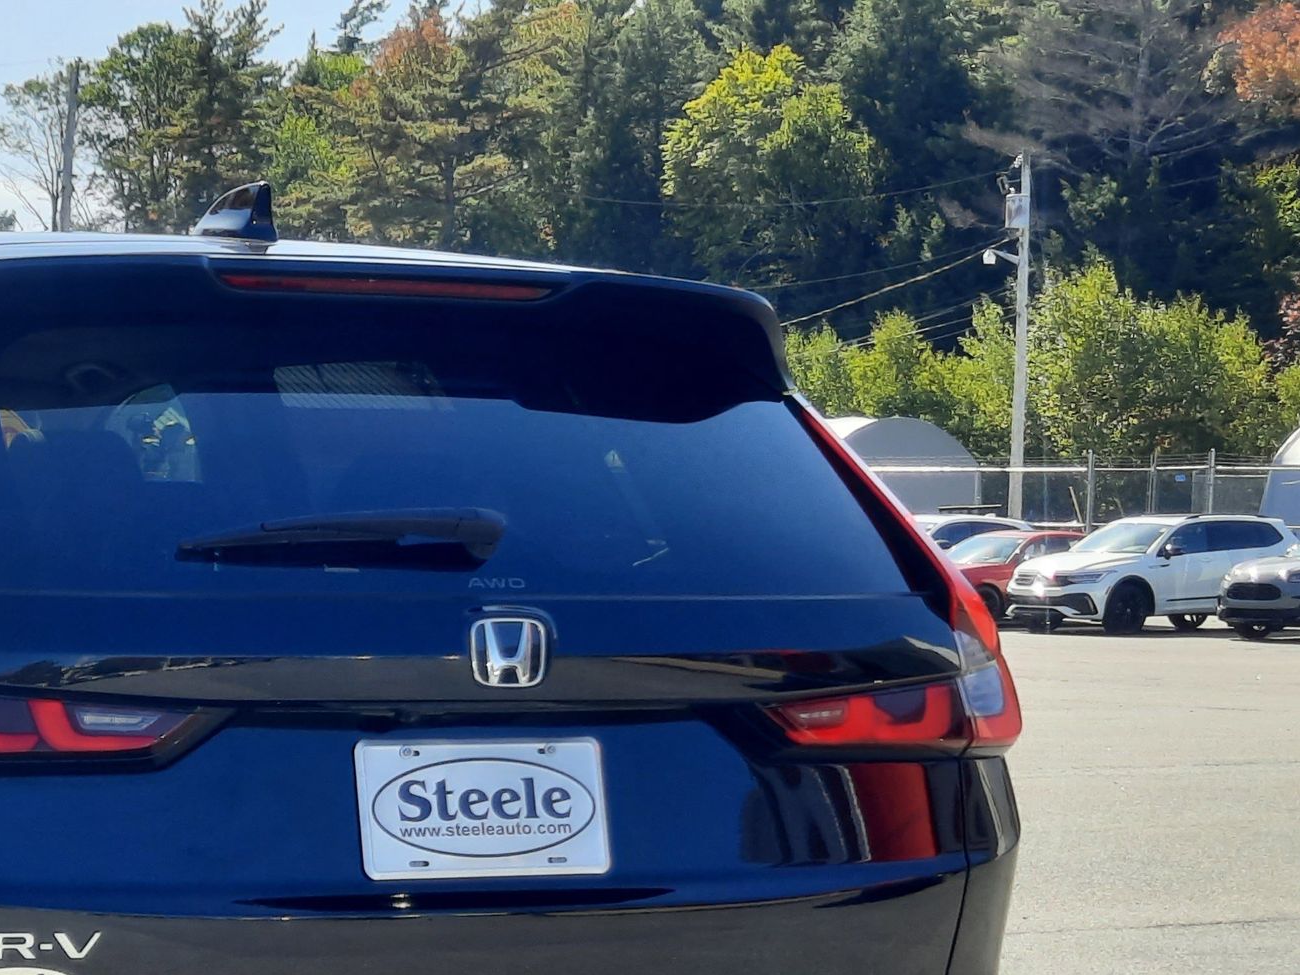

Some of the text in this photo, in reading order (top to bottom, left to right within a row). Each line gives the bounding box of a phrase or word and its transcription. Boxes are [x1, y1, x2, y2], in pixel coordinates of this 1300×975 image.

[467, 577, 526, 589] AWD
[397, 777, 574, 822] Steele
[400, 821, 573, 838] www.steeleauto.com
